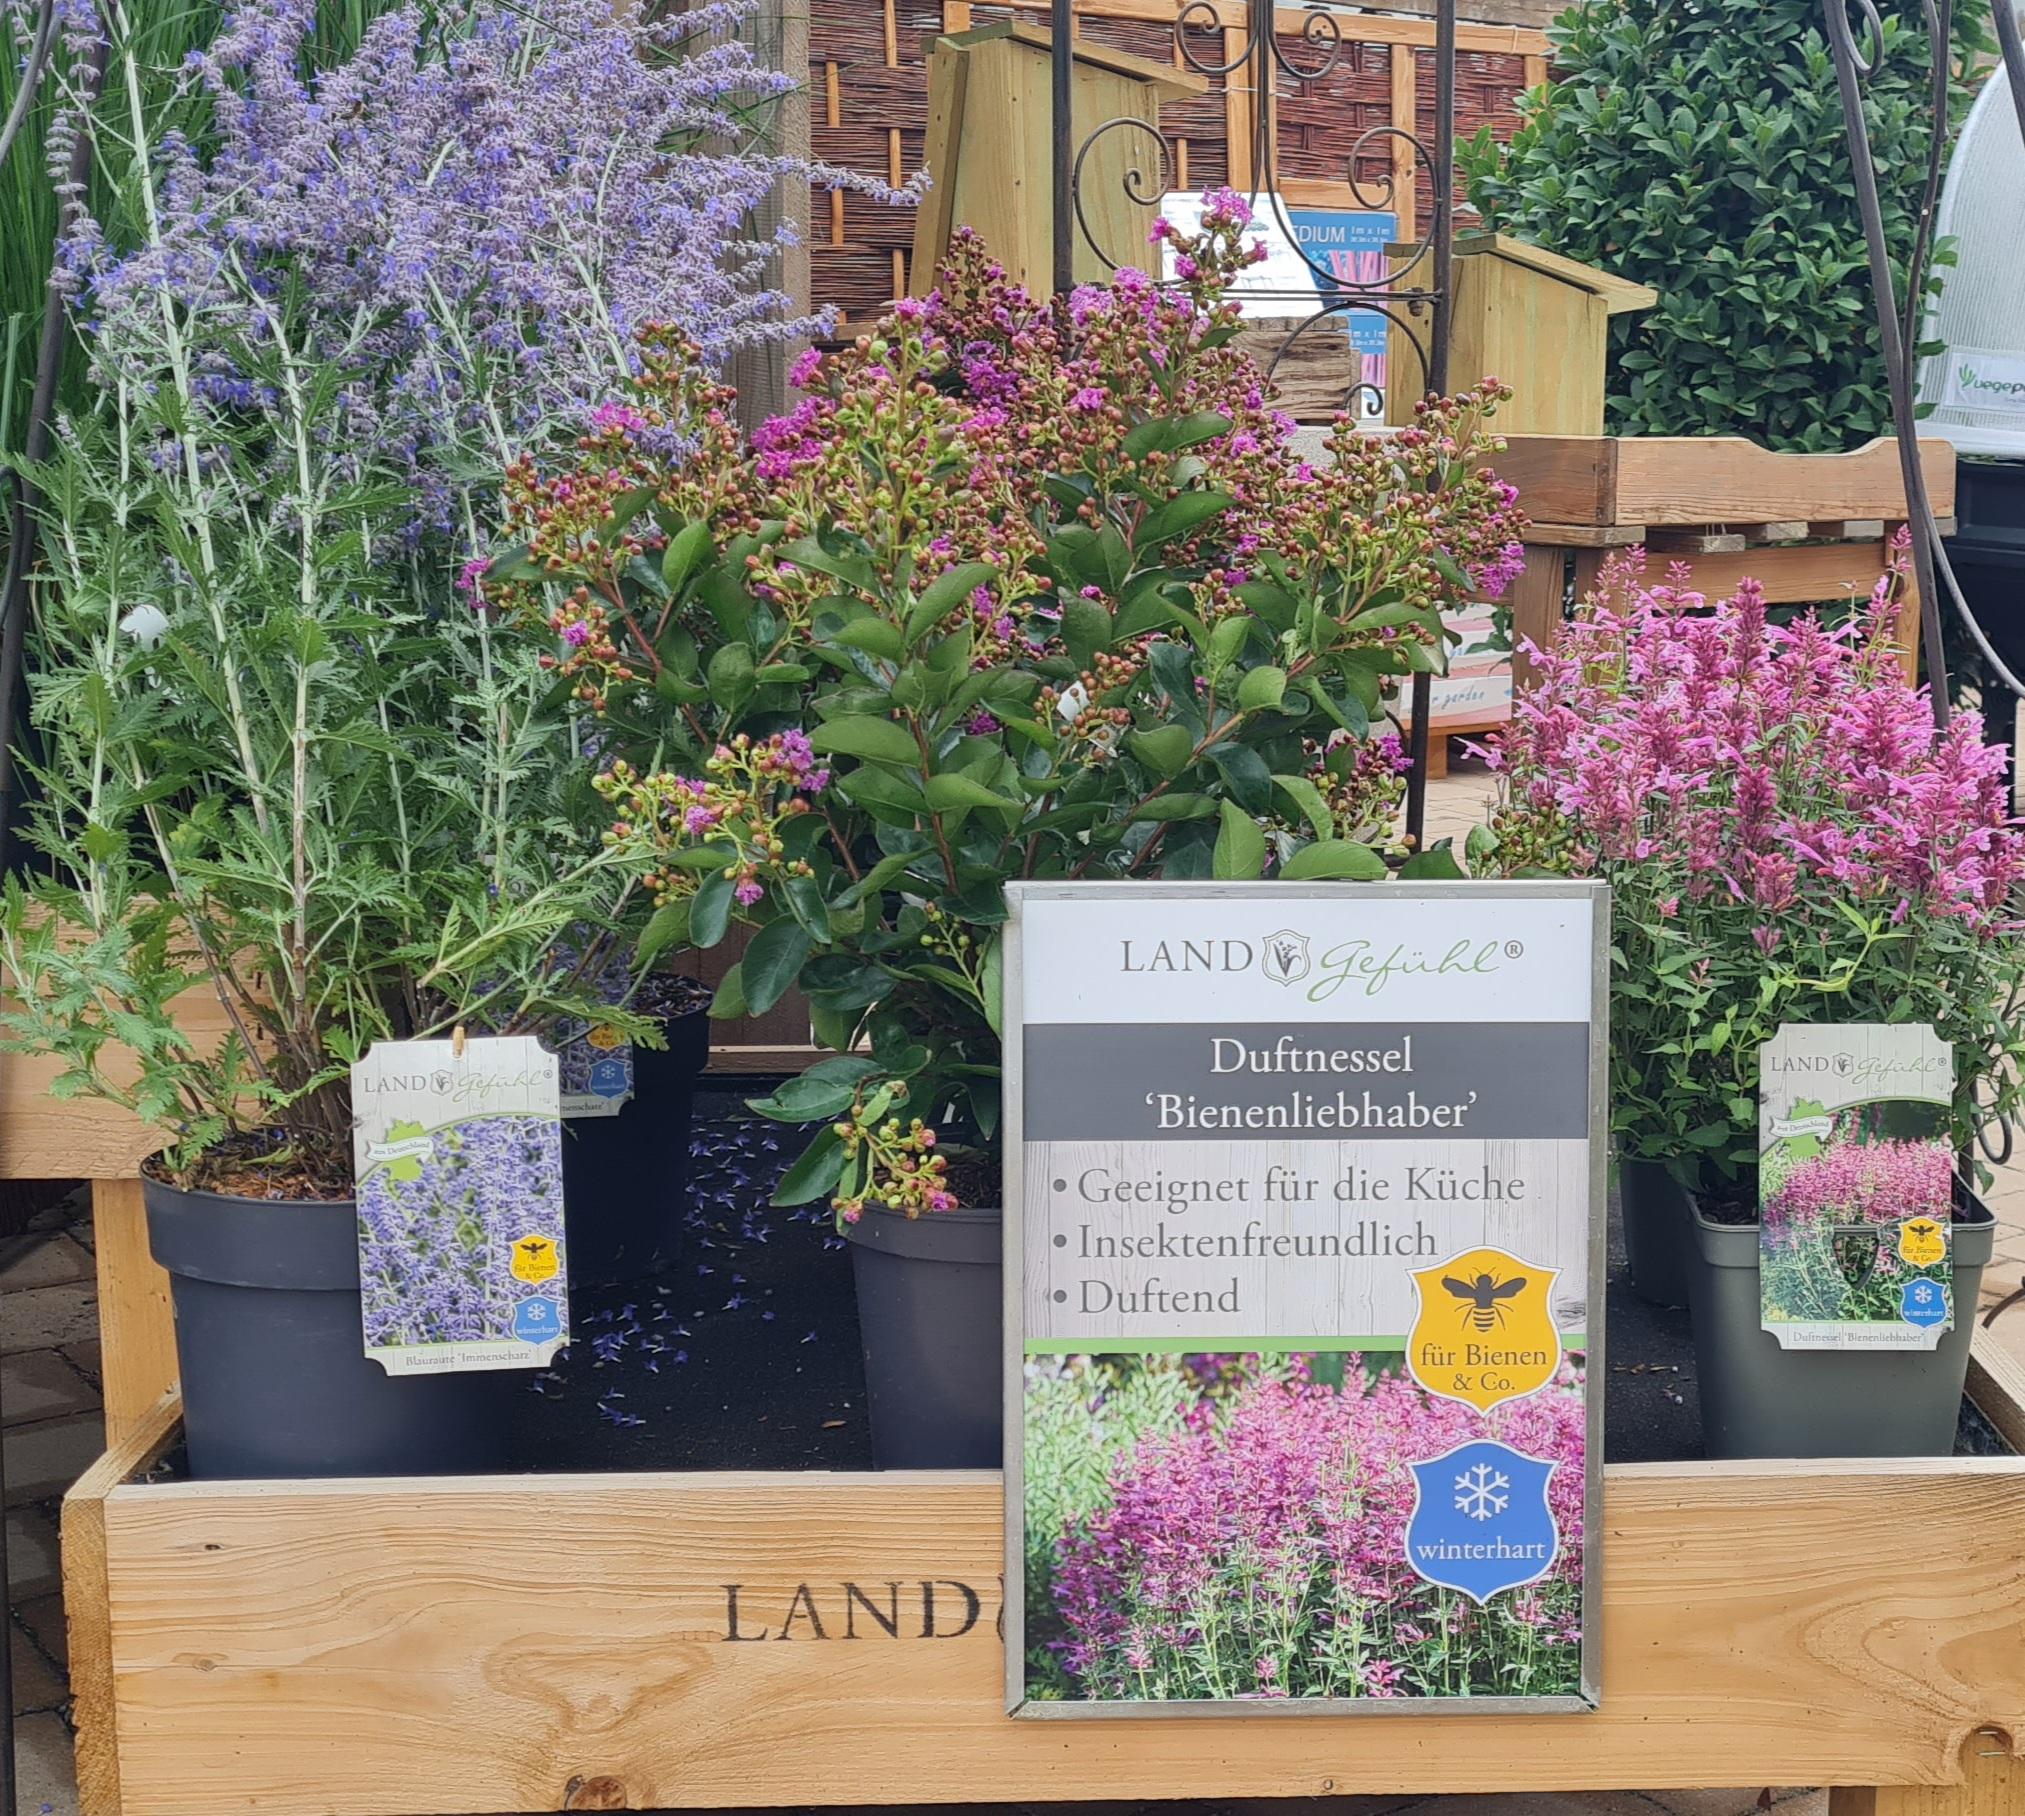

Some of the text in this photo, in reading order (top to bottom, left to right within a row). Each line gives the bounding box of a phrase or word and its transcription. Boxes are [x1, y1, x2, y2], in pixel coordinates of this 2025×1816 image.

[1974, 380, 2025, 395] vegep
[1120, 940, 1254, 973] LAND
[1210, 1036, 1414, 1074] Duftnessel
[1771, 1057, 1829, 1072] LAND
[364, 1074, 426, 1093] LAND
[1145, 1090, 1478, 1129] ‘Bienenliebhaber’
[1078, 1165, 1526, 1214] Geeignet für die Küche
[1078, 1221, 1438, 1259] Insektenfreundlich
[1078, 1277, 1241, 1314] Duftend
[1793, 1332, 1841, 1343] Duftnessel
[405, 1355, 456, 1367] Blauraute
[1421, 1343, 1548, 1366] für Bienen
[1452, 1372, 1516, 1392] & Co.
[1416, 1535, 1546, 1561] winterhart
[719, 1580, 981, 1642] LAND
